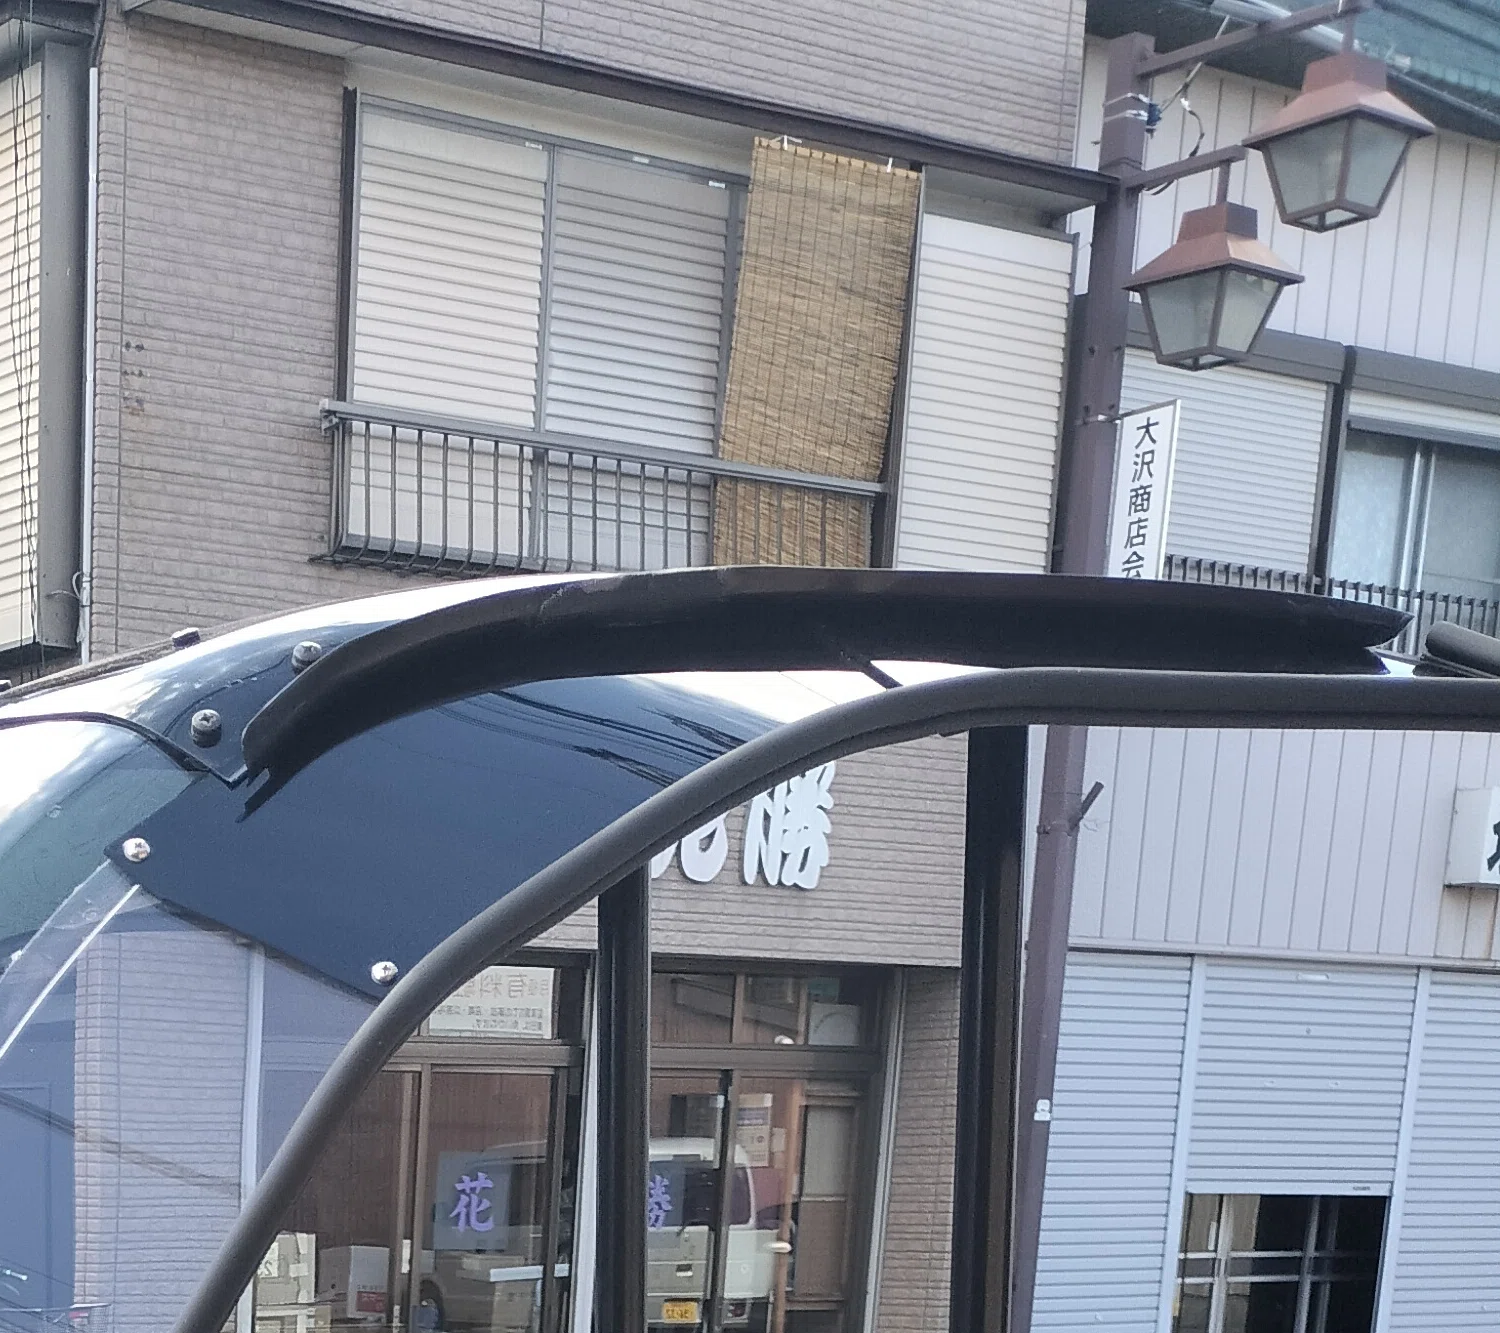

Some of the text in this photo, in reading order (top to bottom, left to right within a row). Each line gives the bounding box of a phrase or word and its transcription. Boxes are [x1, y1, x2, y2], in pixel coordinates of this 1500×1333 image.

[1121, 416, 1160, 579] 大沢商店会
[449, 1171, 495, 1232] 花
